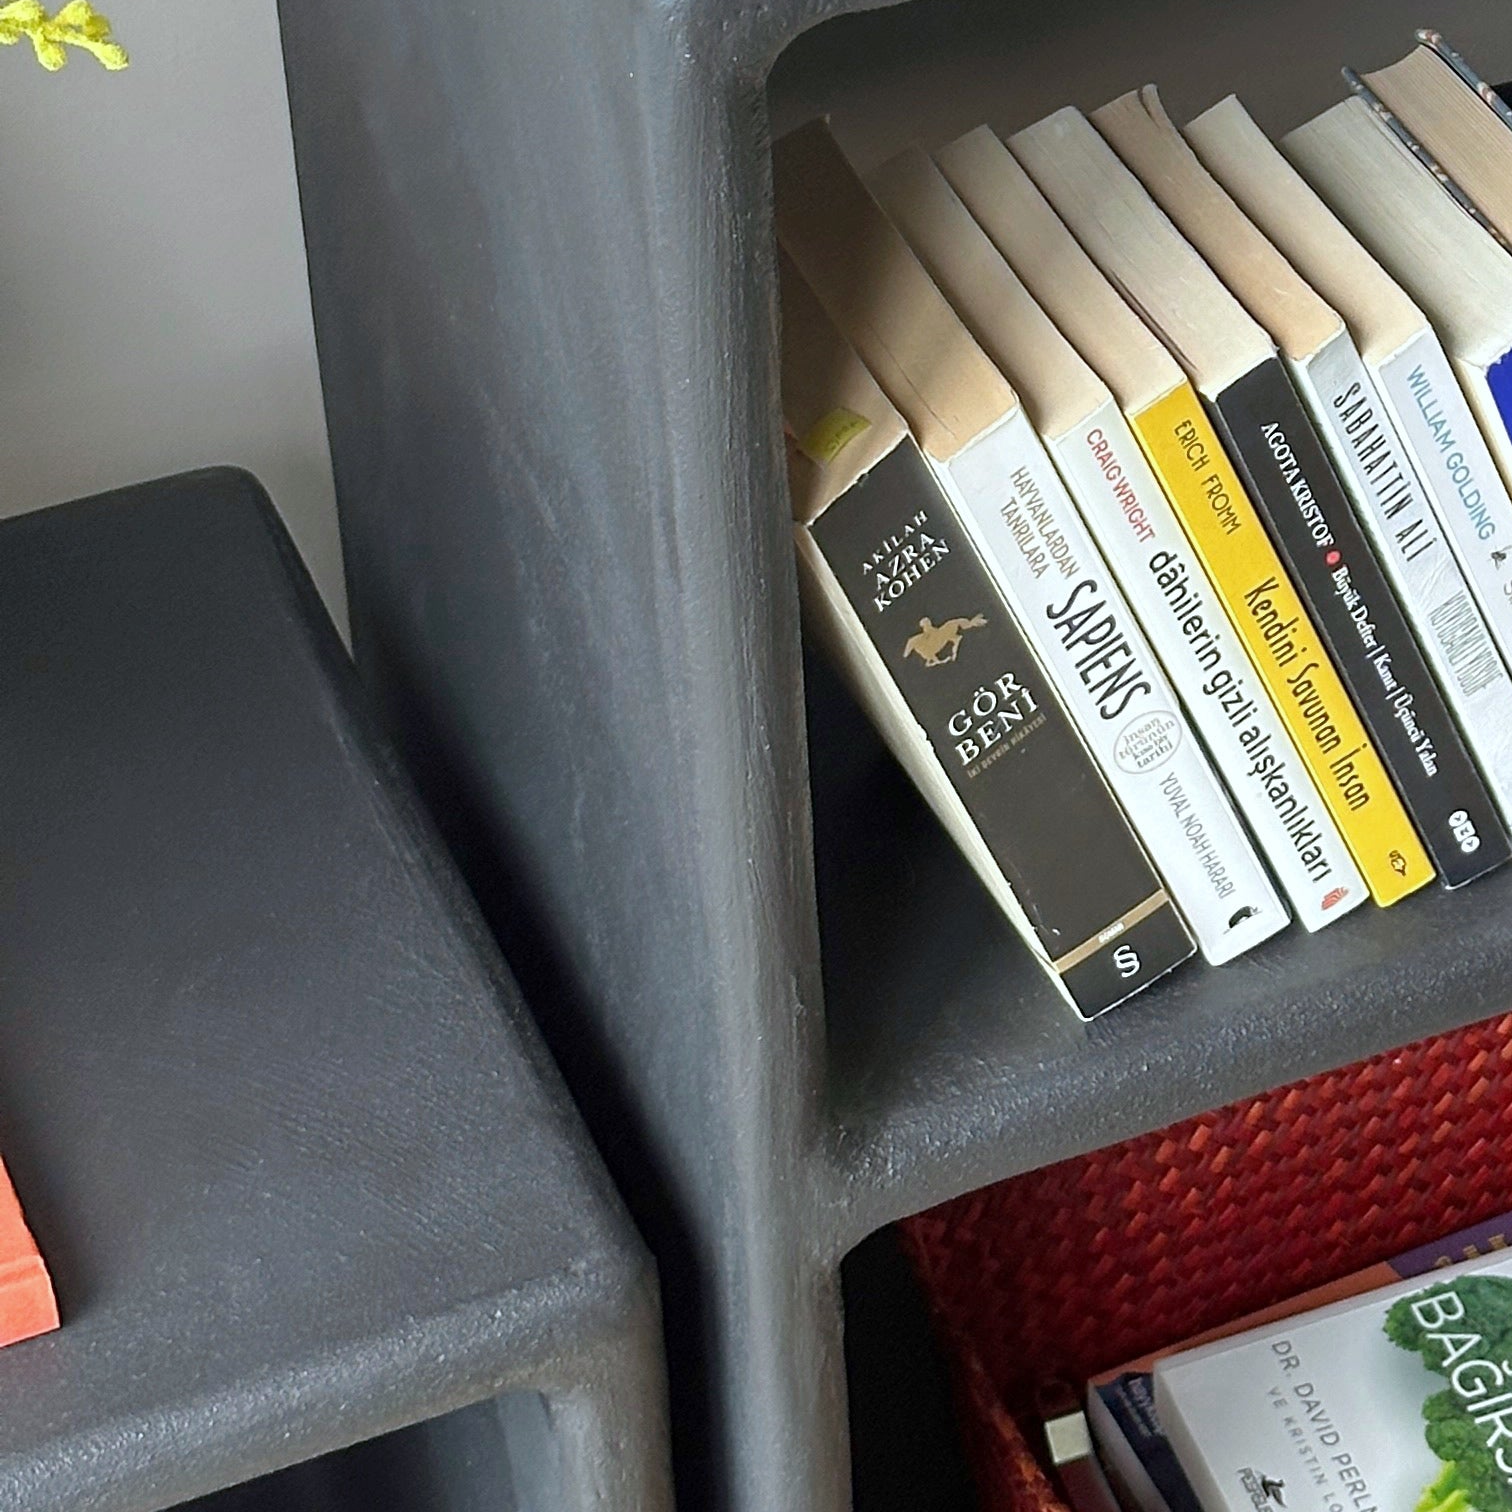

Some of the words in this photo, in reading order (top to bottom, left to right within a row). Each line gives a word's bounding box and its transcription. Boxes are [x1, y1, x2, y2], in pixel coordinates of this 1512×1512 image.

[1086, 428, 1122, 482] CRAIG
[1112, 475, 1157, 544] WRIGHT
[1173, 418, 1211, 472] ERICH
[1200, 473, 1243, 536] FROMM
[1333, 381, 1416, 521] SABAHATTİN
[1394, 518, 1438, 563] ALİ
[1406, 363, 1456, 454] WILLIAM
[1446, 452, 1496, 541] GOLDING
[873, 538, 951, 612] KOHEN
[876, 533, 936, 591] AZRA
[1000, 496, 1051, 580] TANRILARA
[1010, 465, 1081, 580] HAYVANLARDAN
[1046, 578, 1152, 720] SAPIENS
[1260, 421, 1302, 485] AGOTA
[1289, 477, 1337, 549] KRISTOF
[1331, 565, 1360, 612] Büyük
[1350, 604, 1379, 651] Defter
[1415, 735, 1439, 778] Yalan
[948, 672, 1023, 737] GÖR
[1148, 550, 1222, 672] dâhilerin
[1202, 668, 1260, 728] gizli
[1238, 724, 1334, 885] alışkanlıkları
[1243, 575, 1308, 668] Kendini
[1286, 662, 1343, 755] Savunan
[1329, 742, 1371, 812] İnsan
[1159, 771, 1192, 819] YUVAL
[1180, 812, 1213, 856] NOAH
[1198, 848, 1237, 900] HARARI
[1267, 1386, 1289, 1409] VE
[1283, 1416, 1329, 1486] KRISTIN
[1271, 1340, 1300, 1378] DR.
[1293, 1382, 1341, 1446] DAVID
